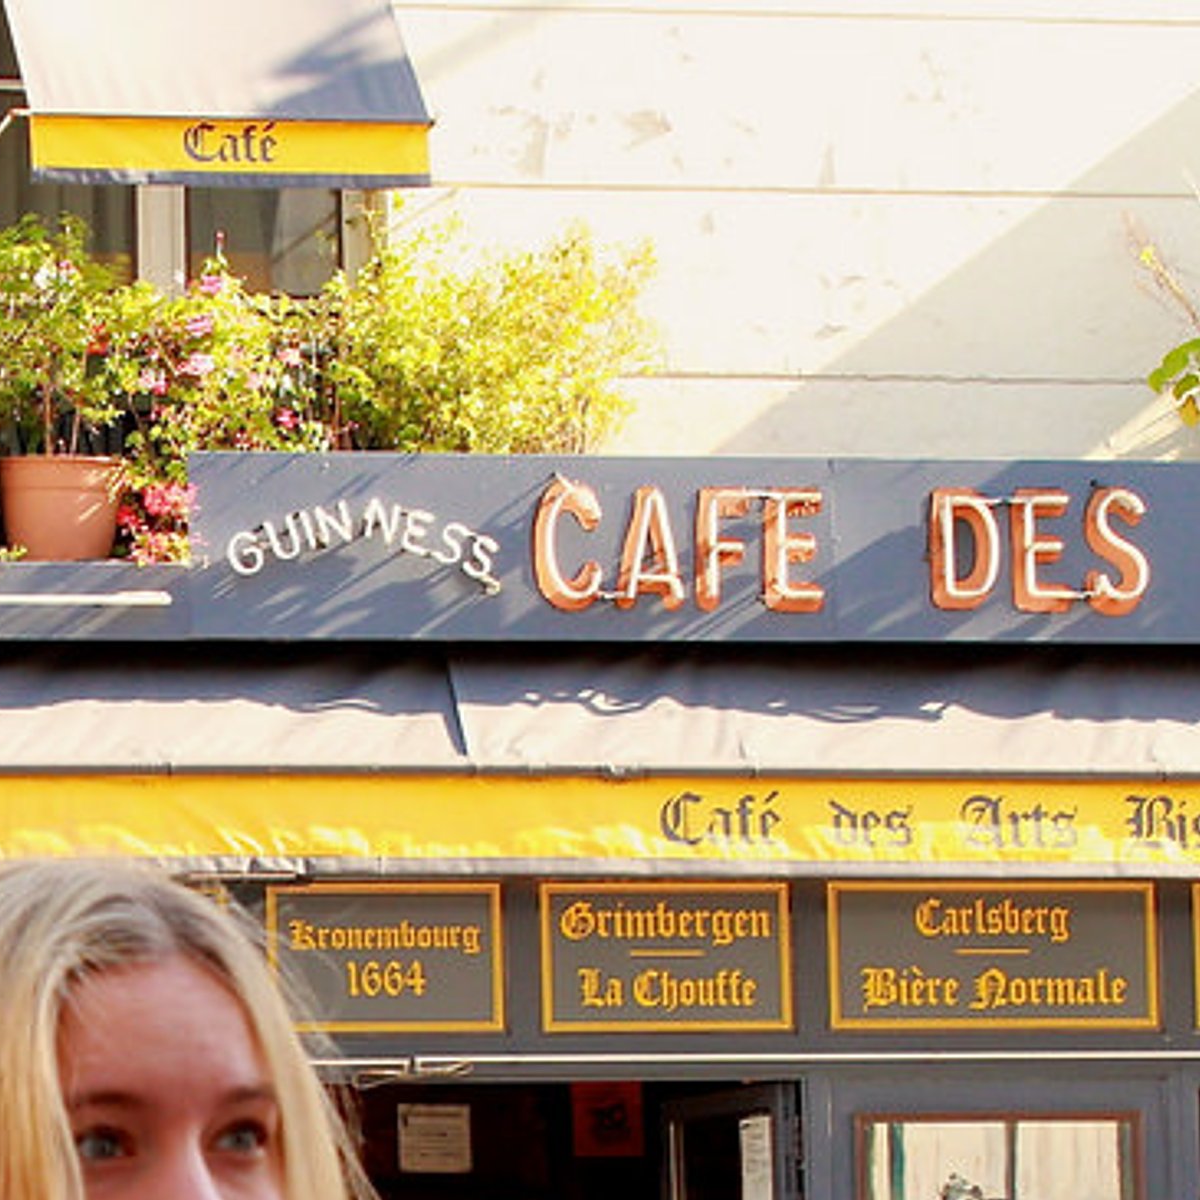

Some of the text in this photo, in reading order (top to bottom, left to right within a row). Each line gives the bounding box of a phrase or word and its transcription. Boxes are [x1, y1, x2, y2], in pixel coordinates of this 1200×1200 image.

[184, 121, 277, 162] Café
[226, 498, 500, 592] GUINNESS
[531, 480, 1149, 616] CAFE DES
[660, 791, 781, 846] Café
[829, 800, 914, 847] des
[961, 794, 1078, 849] Arts
[560, 901, 771, 947] Grimbergen
[915, 898, 1071, 943] Carlsberg
[346, 959, 427, 998] 1664
[578, 968, 757, 1013] La Chouffe
[861, 965, 1128, 1014] Bière Normale
